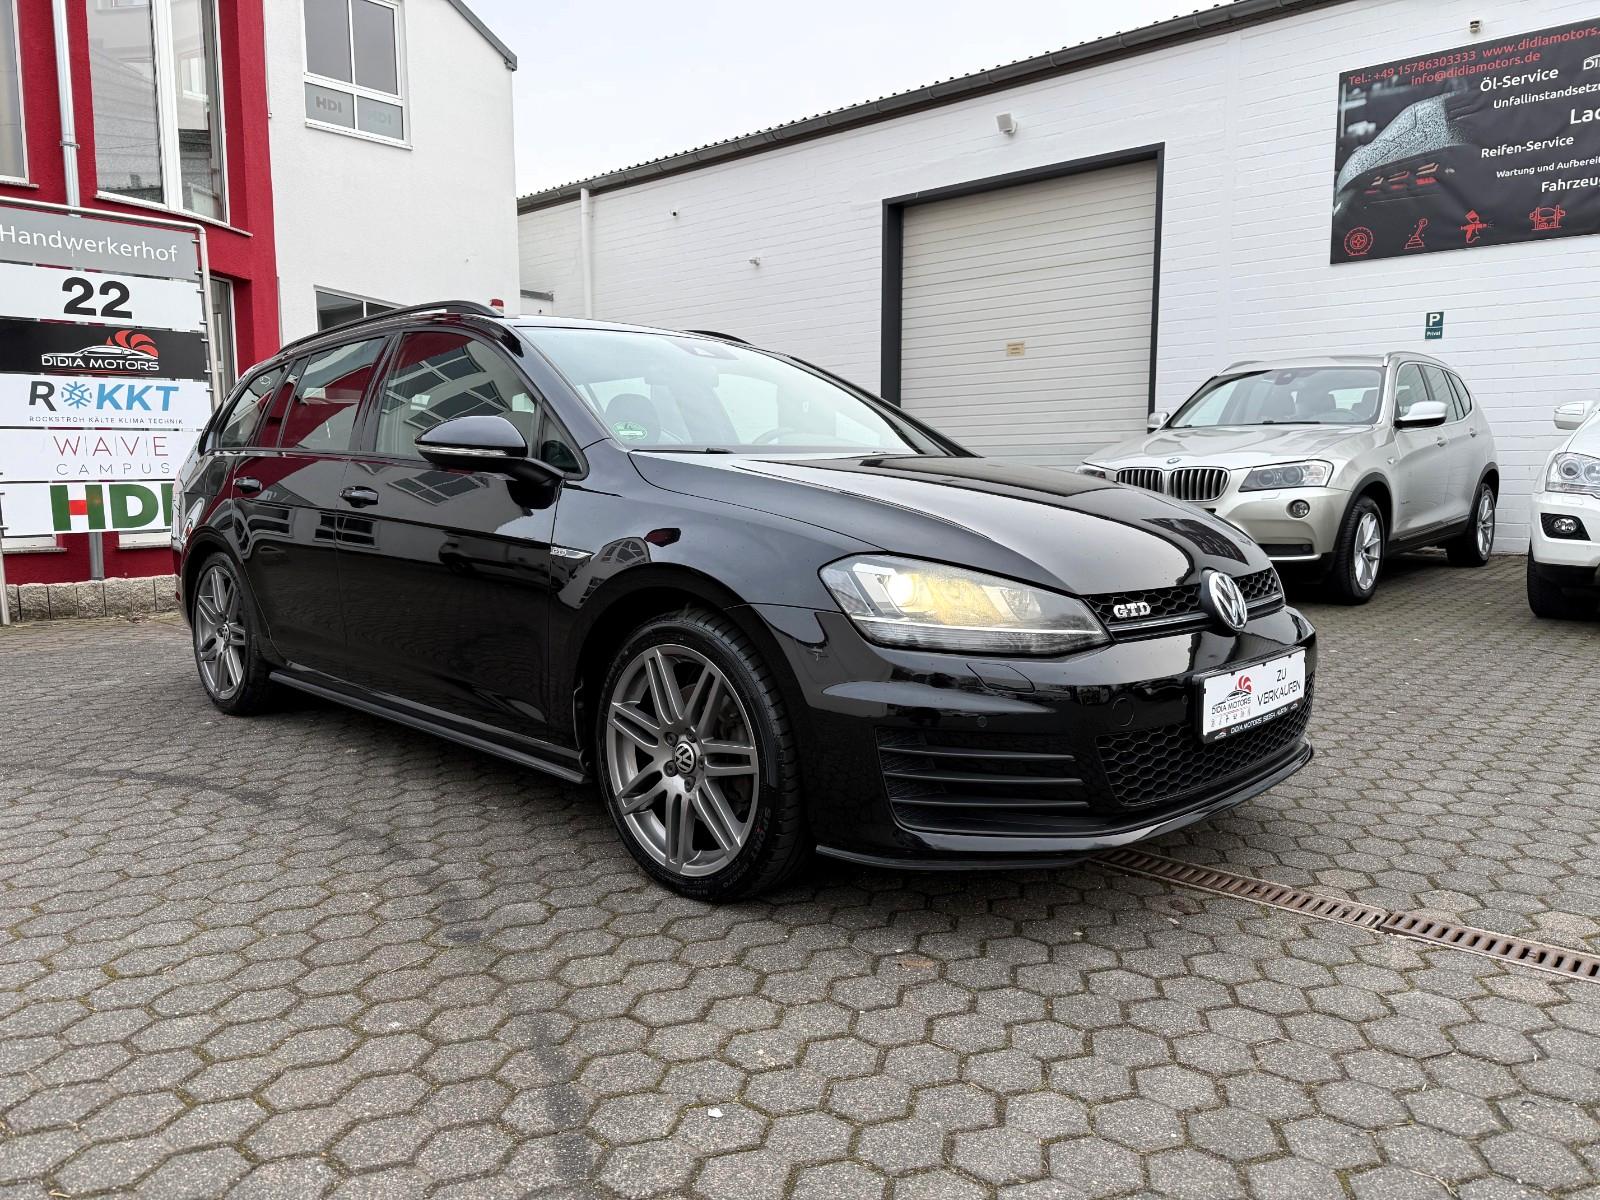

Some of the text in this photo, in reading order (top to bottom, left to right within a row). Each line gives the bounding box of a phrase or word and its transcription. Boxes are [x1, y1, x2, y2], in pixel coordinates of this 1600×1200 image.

[1349, 73, 1371, 85] Tel.:
[1374, 67, 1394, 80] +49
[1398, 50, 1476, 76] 15786303333
[1411, 52, 1541, 86] info@didiamotors.de
[1583, 59, 1600, 70] DI
[1480, 69, 1559, 92] Öl-Service
[315, 96, 342, 112] HDI
[1481, 136, 1575, 158] Reifen-Service
[1496, 167, 1535, 178] Wartung
[1537, 162, 1555, 173] und
[1541, 176, 1600, 193] Fahrzeu
[0, 224, 178, 262] Handwerkerhof
[62, 277, 133, 319] 22
[1429, 313, 1440, 326] P
[41, 355, 160, 371] DIDIA MOTORS
[29, 415, 85, 423] ROCKSTROH
[88, 416, 115, 424] KÄLTE
[148, 417, 184, 425] TECHNIK
[56, 462, 170, 476] CAMPUS
[1113, 601, 1151, 619] GTD
[1276, 667, 1287, 682] ZU
[1257, 679, 1301, 706] VERKAUFEN
[1228, 696, 1252, 709] MOTORS
